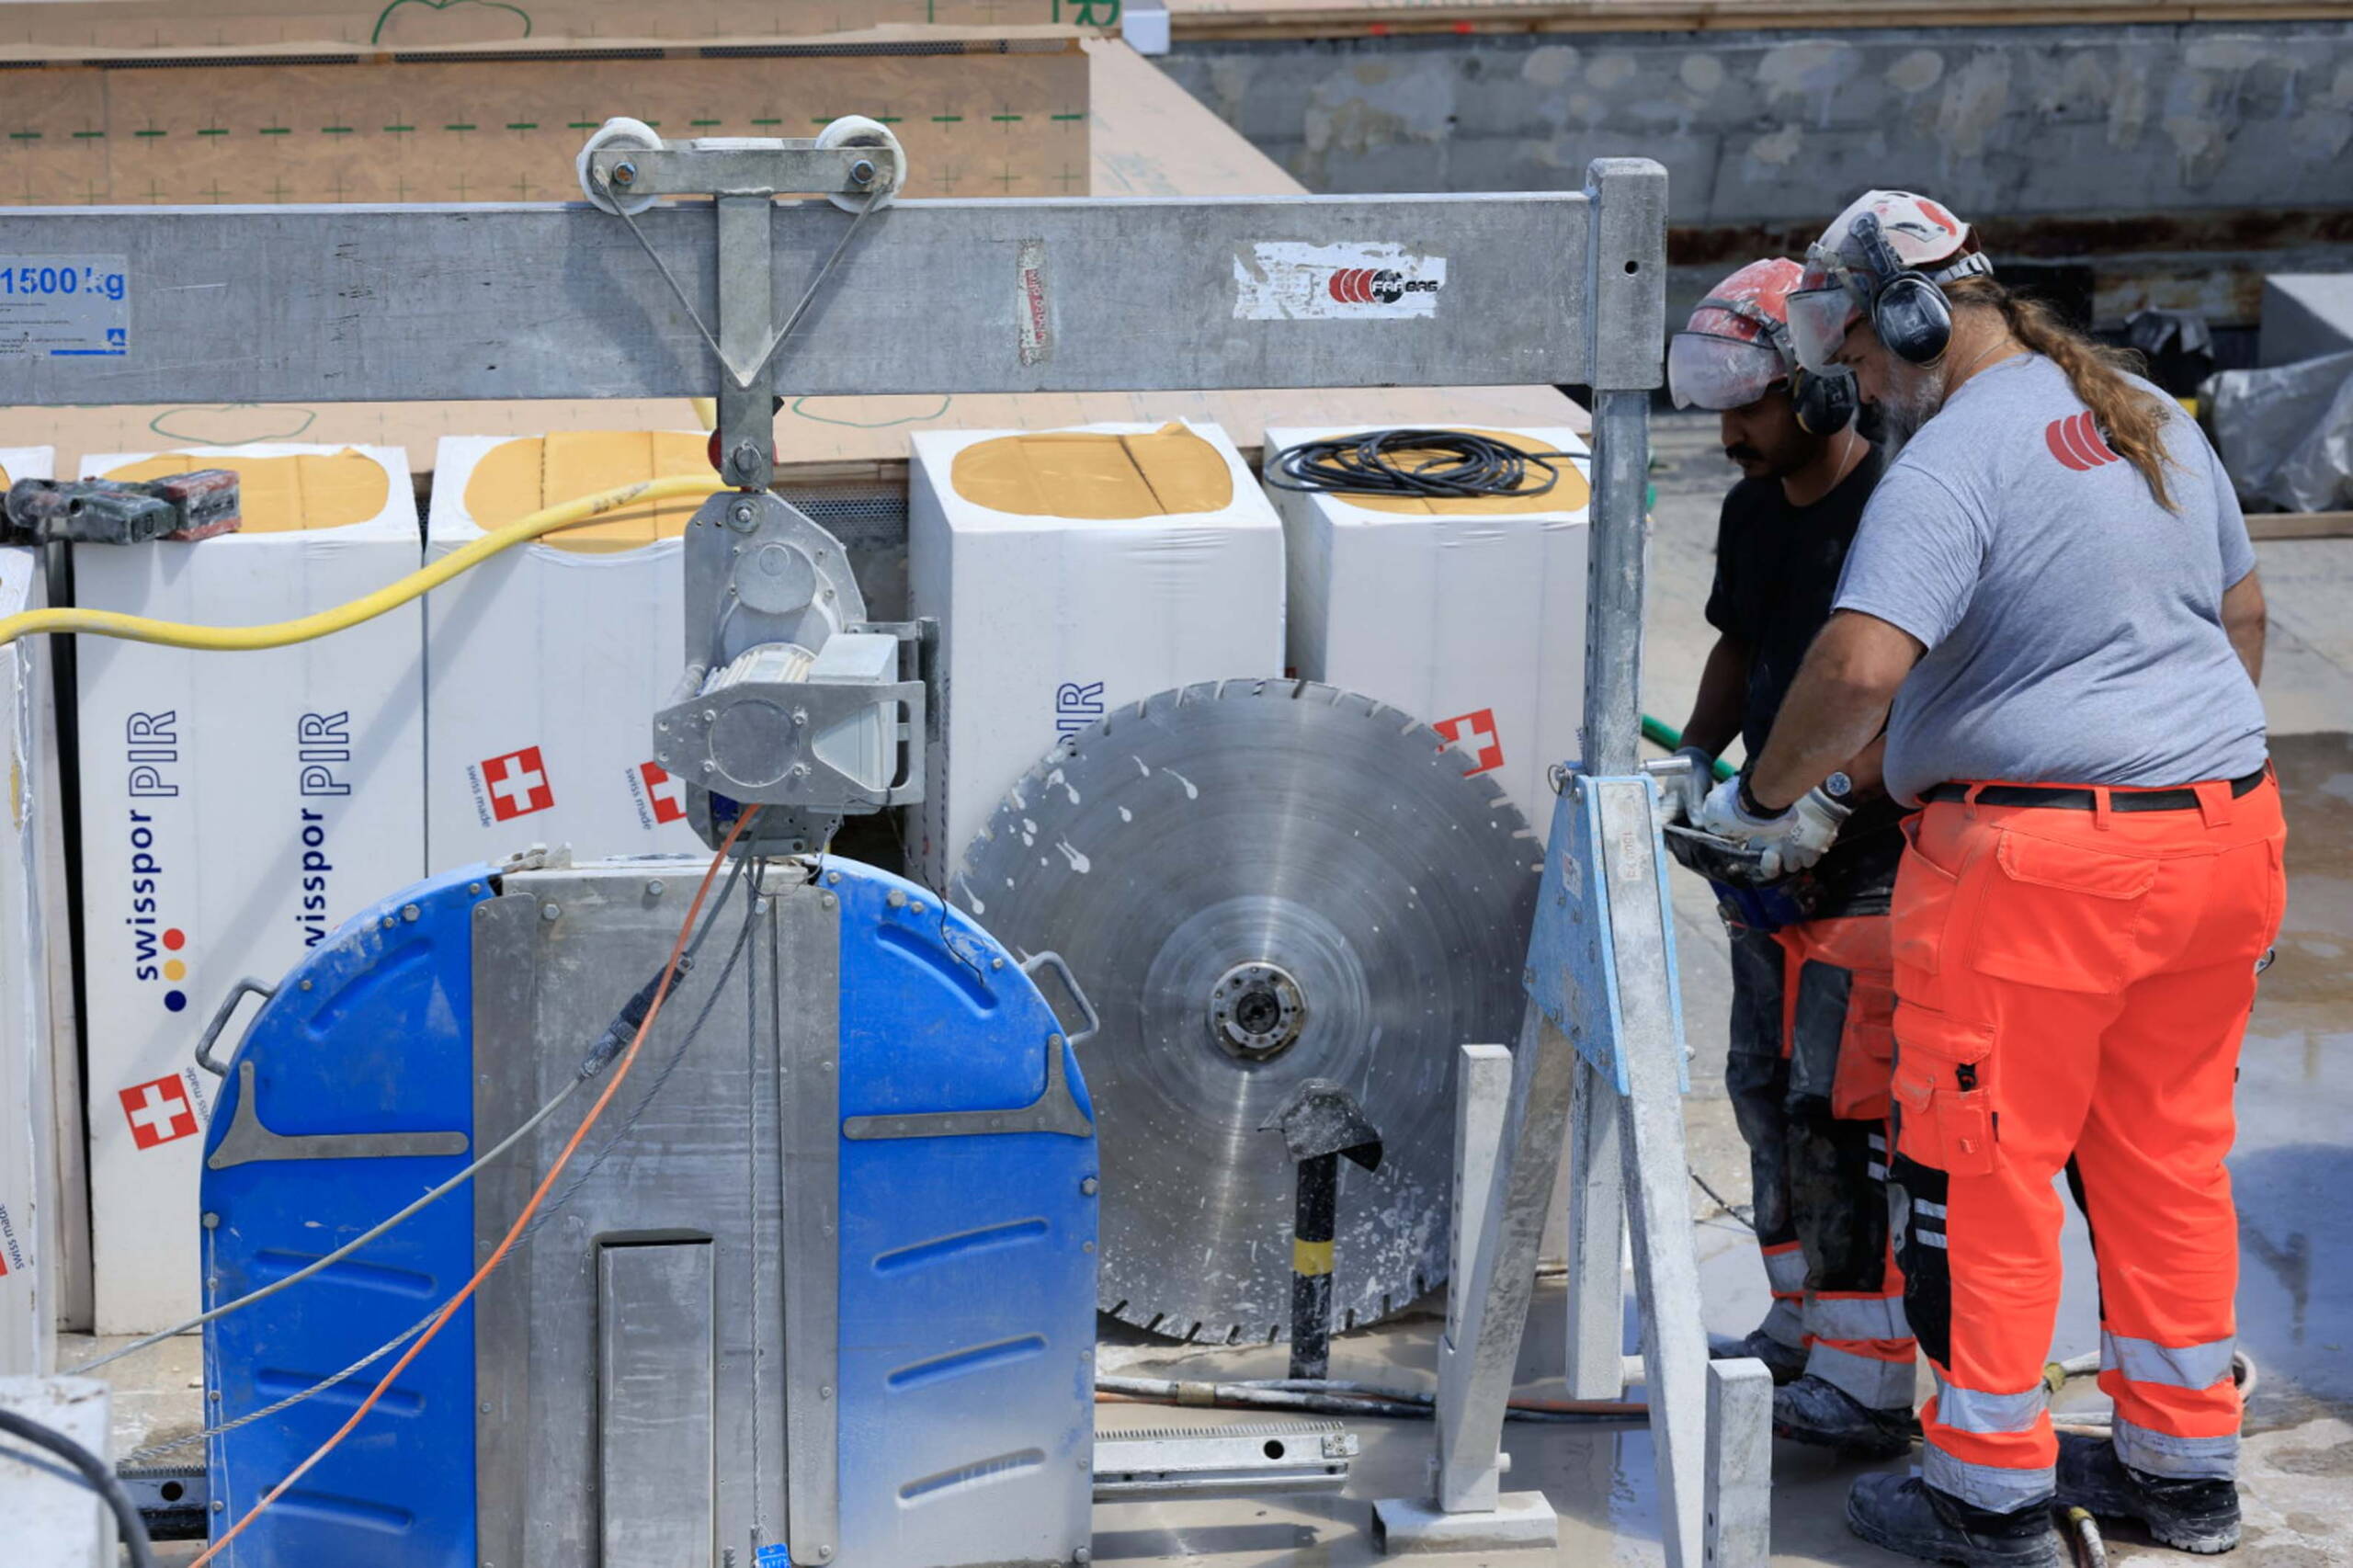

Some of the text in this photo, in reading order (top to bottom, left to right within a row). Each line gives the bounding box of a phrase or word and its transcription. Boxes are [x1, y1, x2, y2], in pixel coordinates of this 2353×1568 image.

[0, 267, 76, 294] 1500
[466, 765, 491, 827] swiss made
[625, 768, 651, 830] swiss made
[126, 710, 179, 981] swisspor PIR
[296, 710, 351, 949] wisspor PIR
[185, 1067, 202, 1098] made
[7, 1239, 25, 1269] swiss
